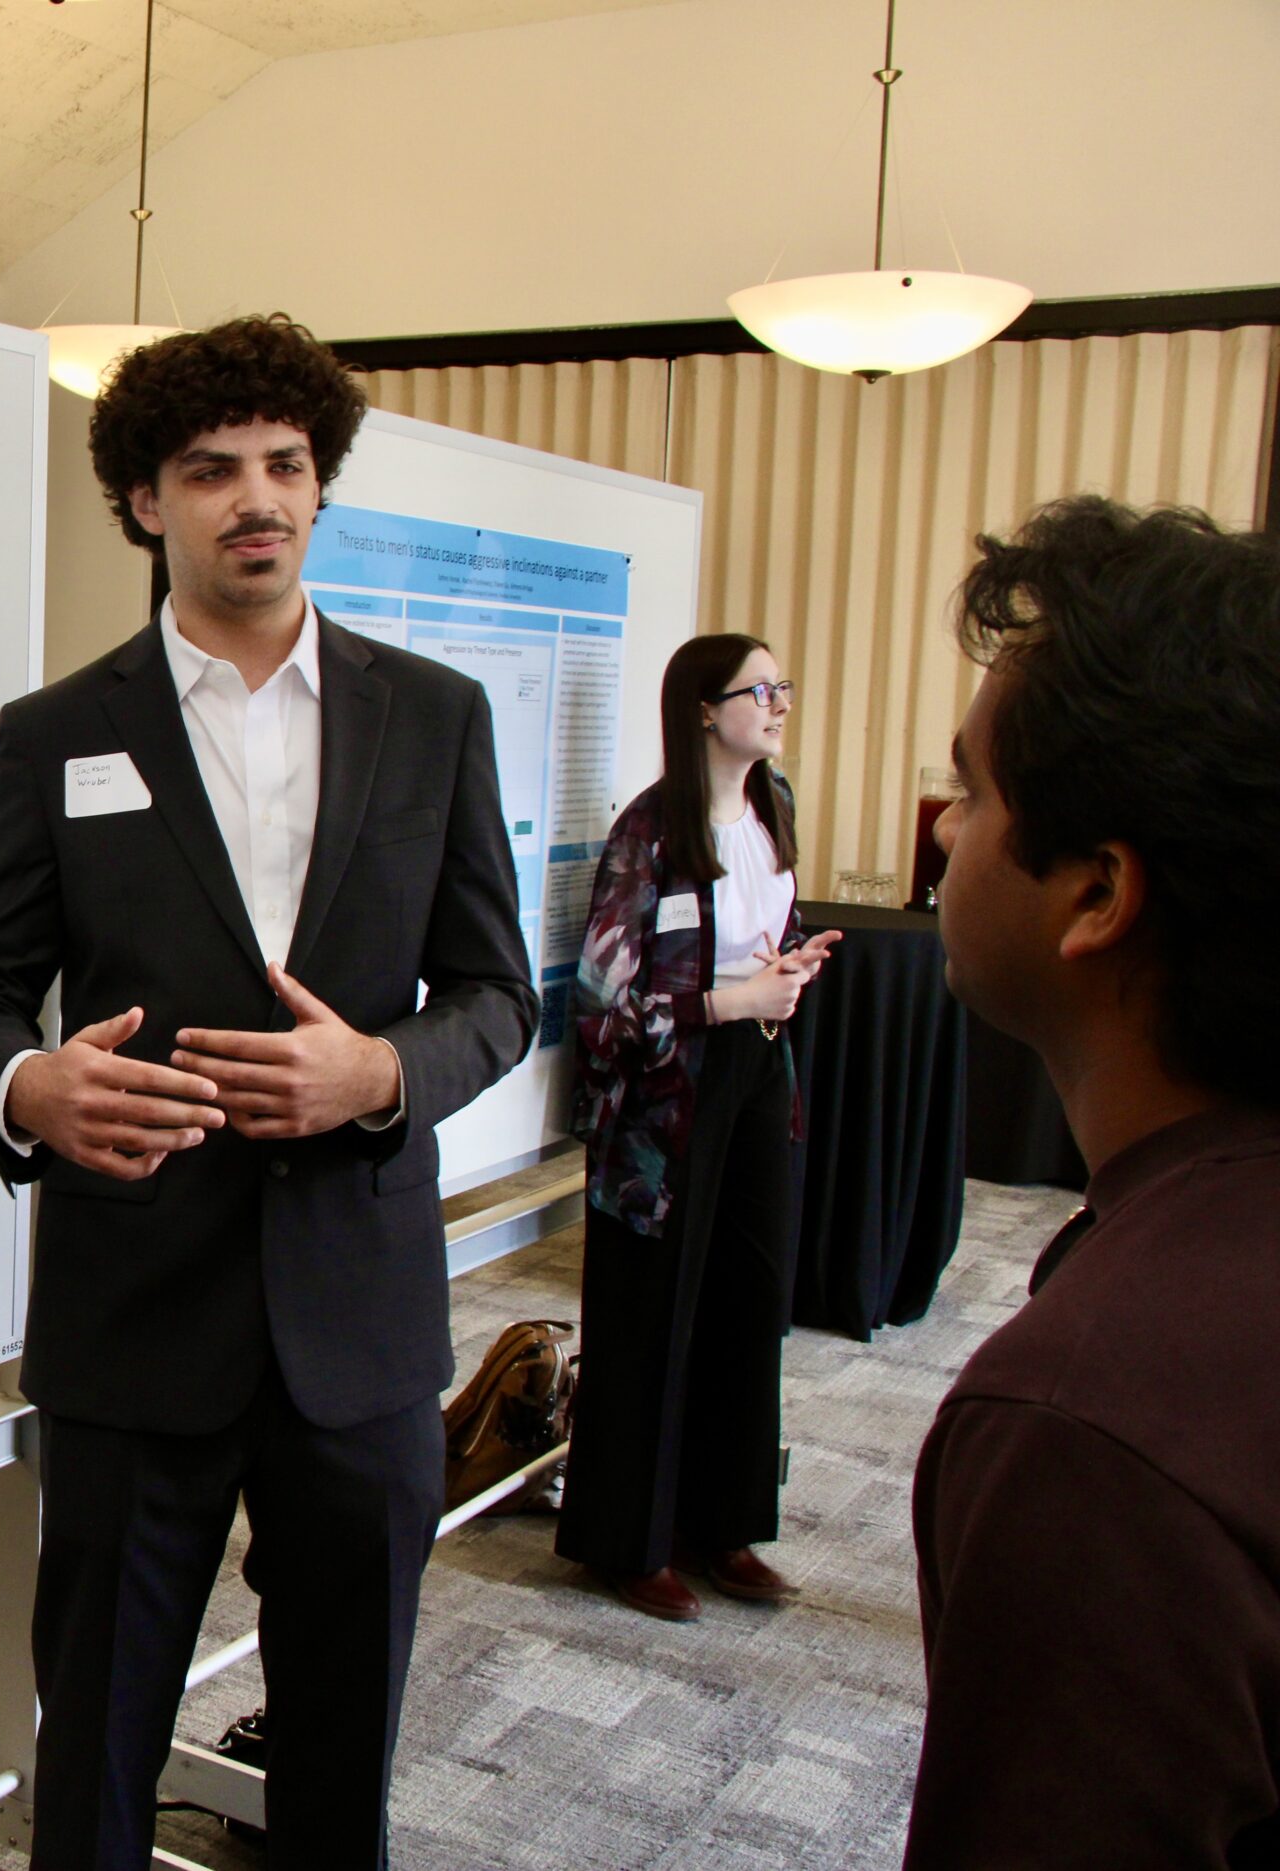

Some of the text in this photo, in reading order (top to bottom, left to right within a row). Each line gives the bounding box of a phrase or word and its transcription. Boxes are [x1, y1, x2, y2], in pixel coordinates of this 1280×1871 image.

[337, 530, 608, 584] Threats to men's status causes aggressive inclinations against a partner
